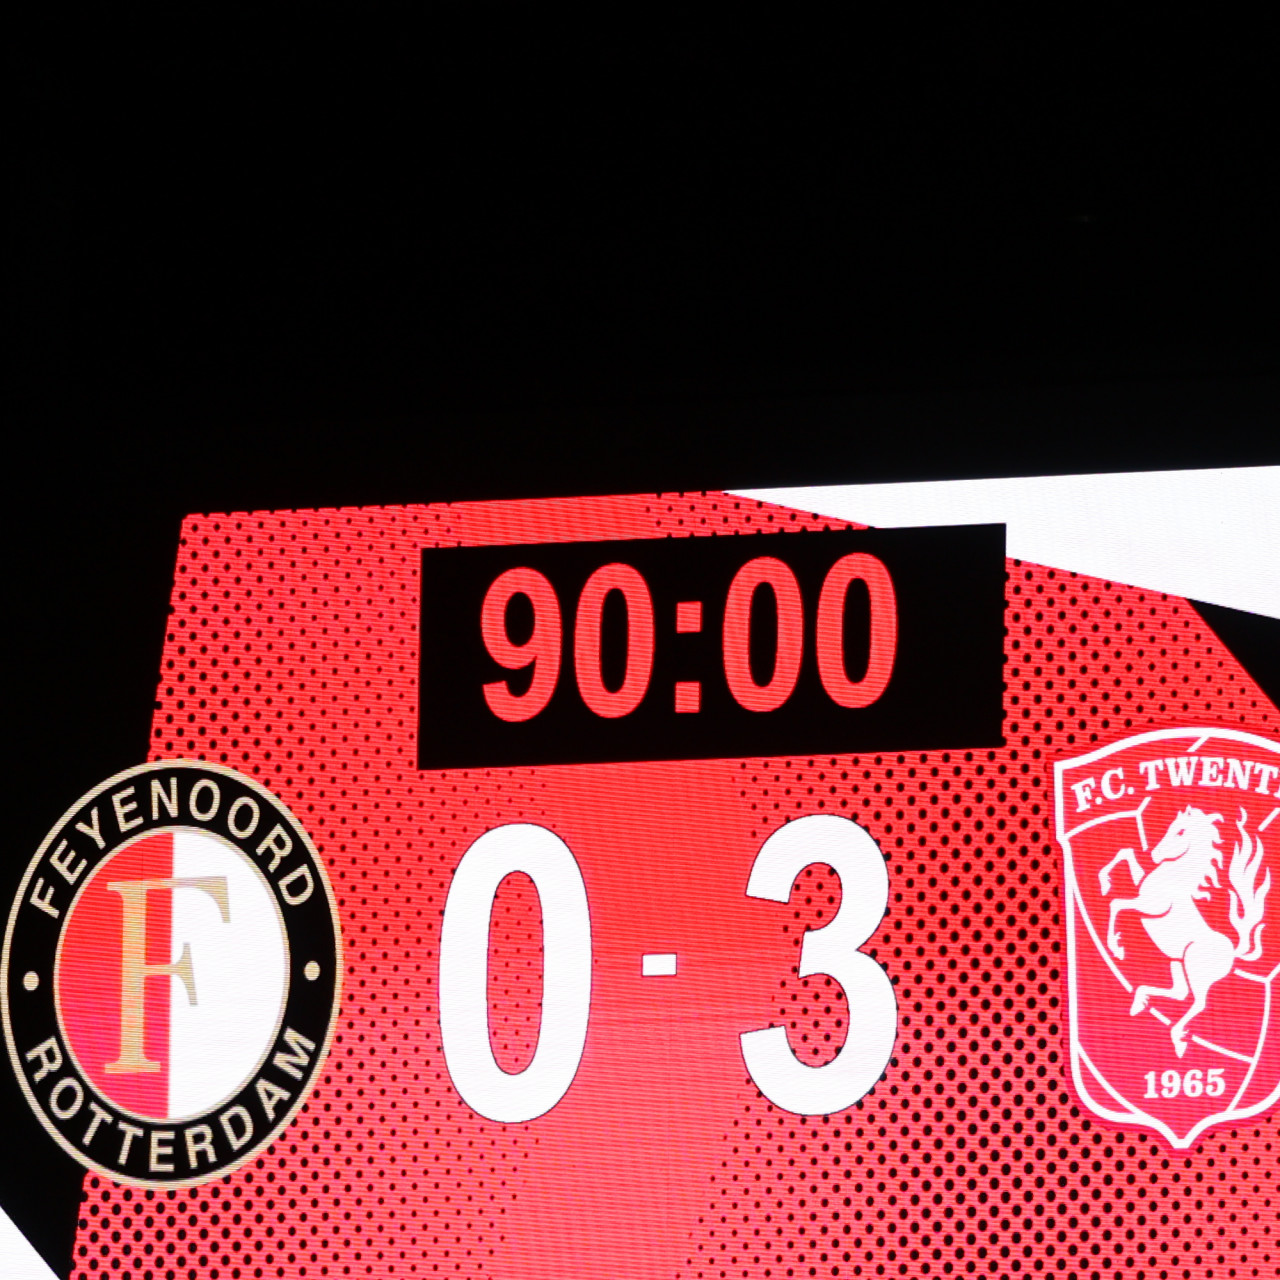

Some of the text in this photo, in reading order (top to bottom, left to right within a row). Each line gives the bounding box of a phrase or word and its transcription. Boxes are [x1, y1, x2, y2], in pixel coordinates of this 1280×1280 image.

[479, 552, 900, 724] 90:00
[29, 777, 315, 918] FEYENOORD
[1071, 767, 1134, 812] F.C.
[104, 876, 231, 1074] F
[437, 823, 593, 1123] 0
[739, 814, 900, 1115] 3
[26, 1026, 317, 1173] ROTTERDAM
[1141, 1068, 1228, 1099] 1965
